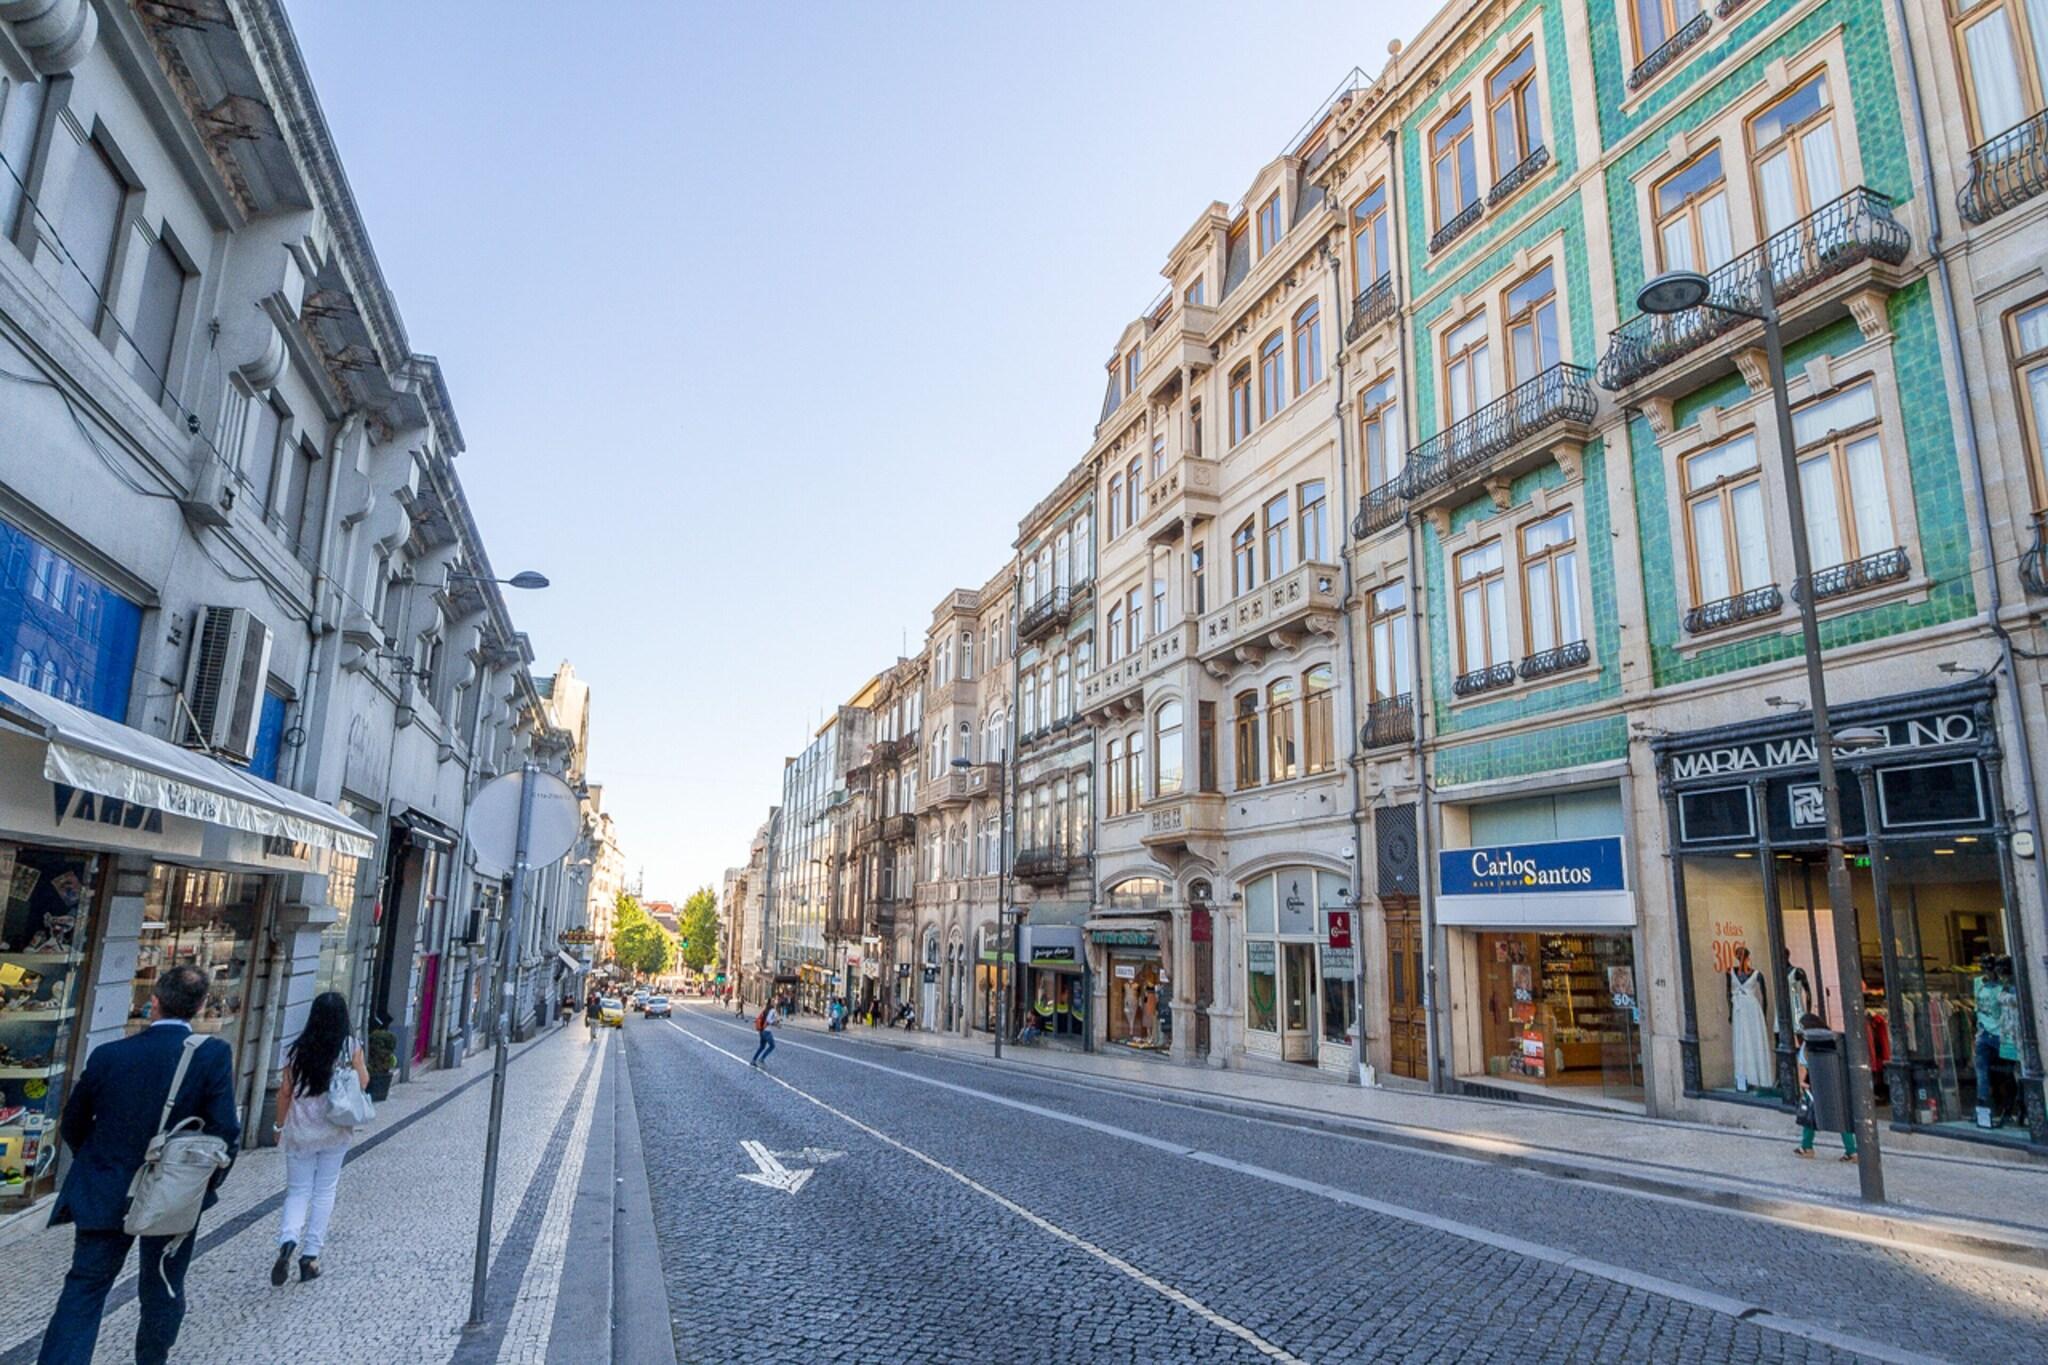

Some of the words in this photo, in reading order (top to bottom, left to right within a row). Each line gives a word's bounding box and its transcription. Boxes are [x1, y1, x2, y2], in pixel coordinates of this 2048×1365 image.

[1673, 746, 1760, 780] MARIA
[1715, 921, 1722, 936] 3
[1723, 921, 1743, 936] dias
